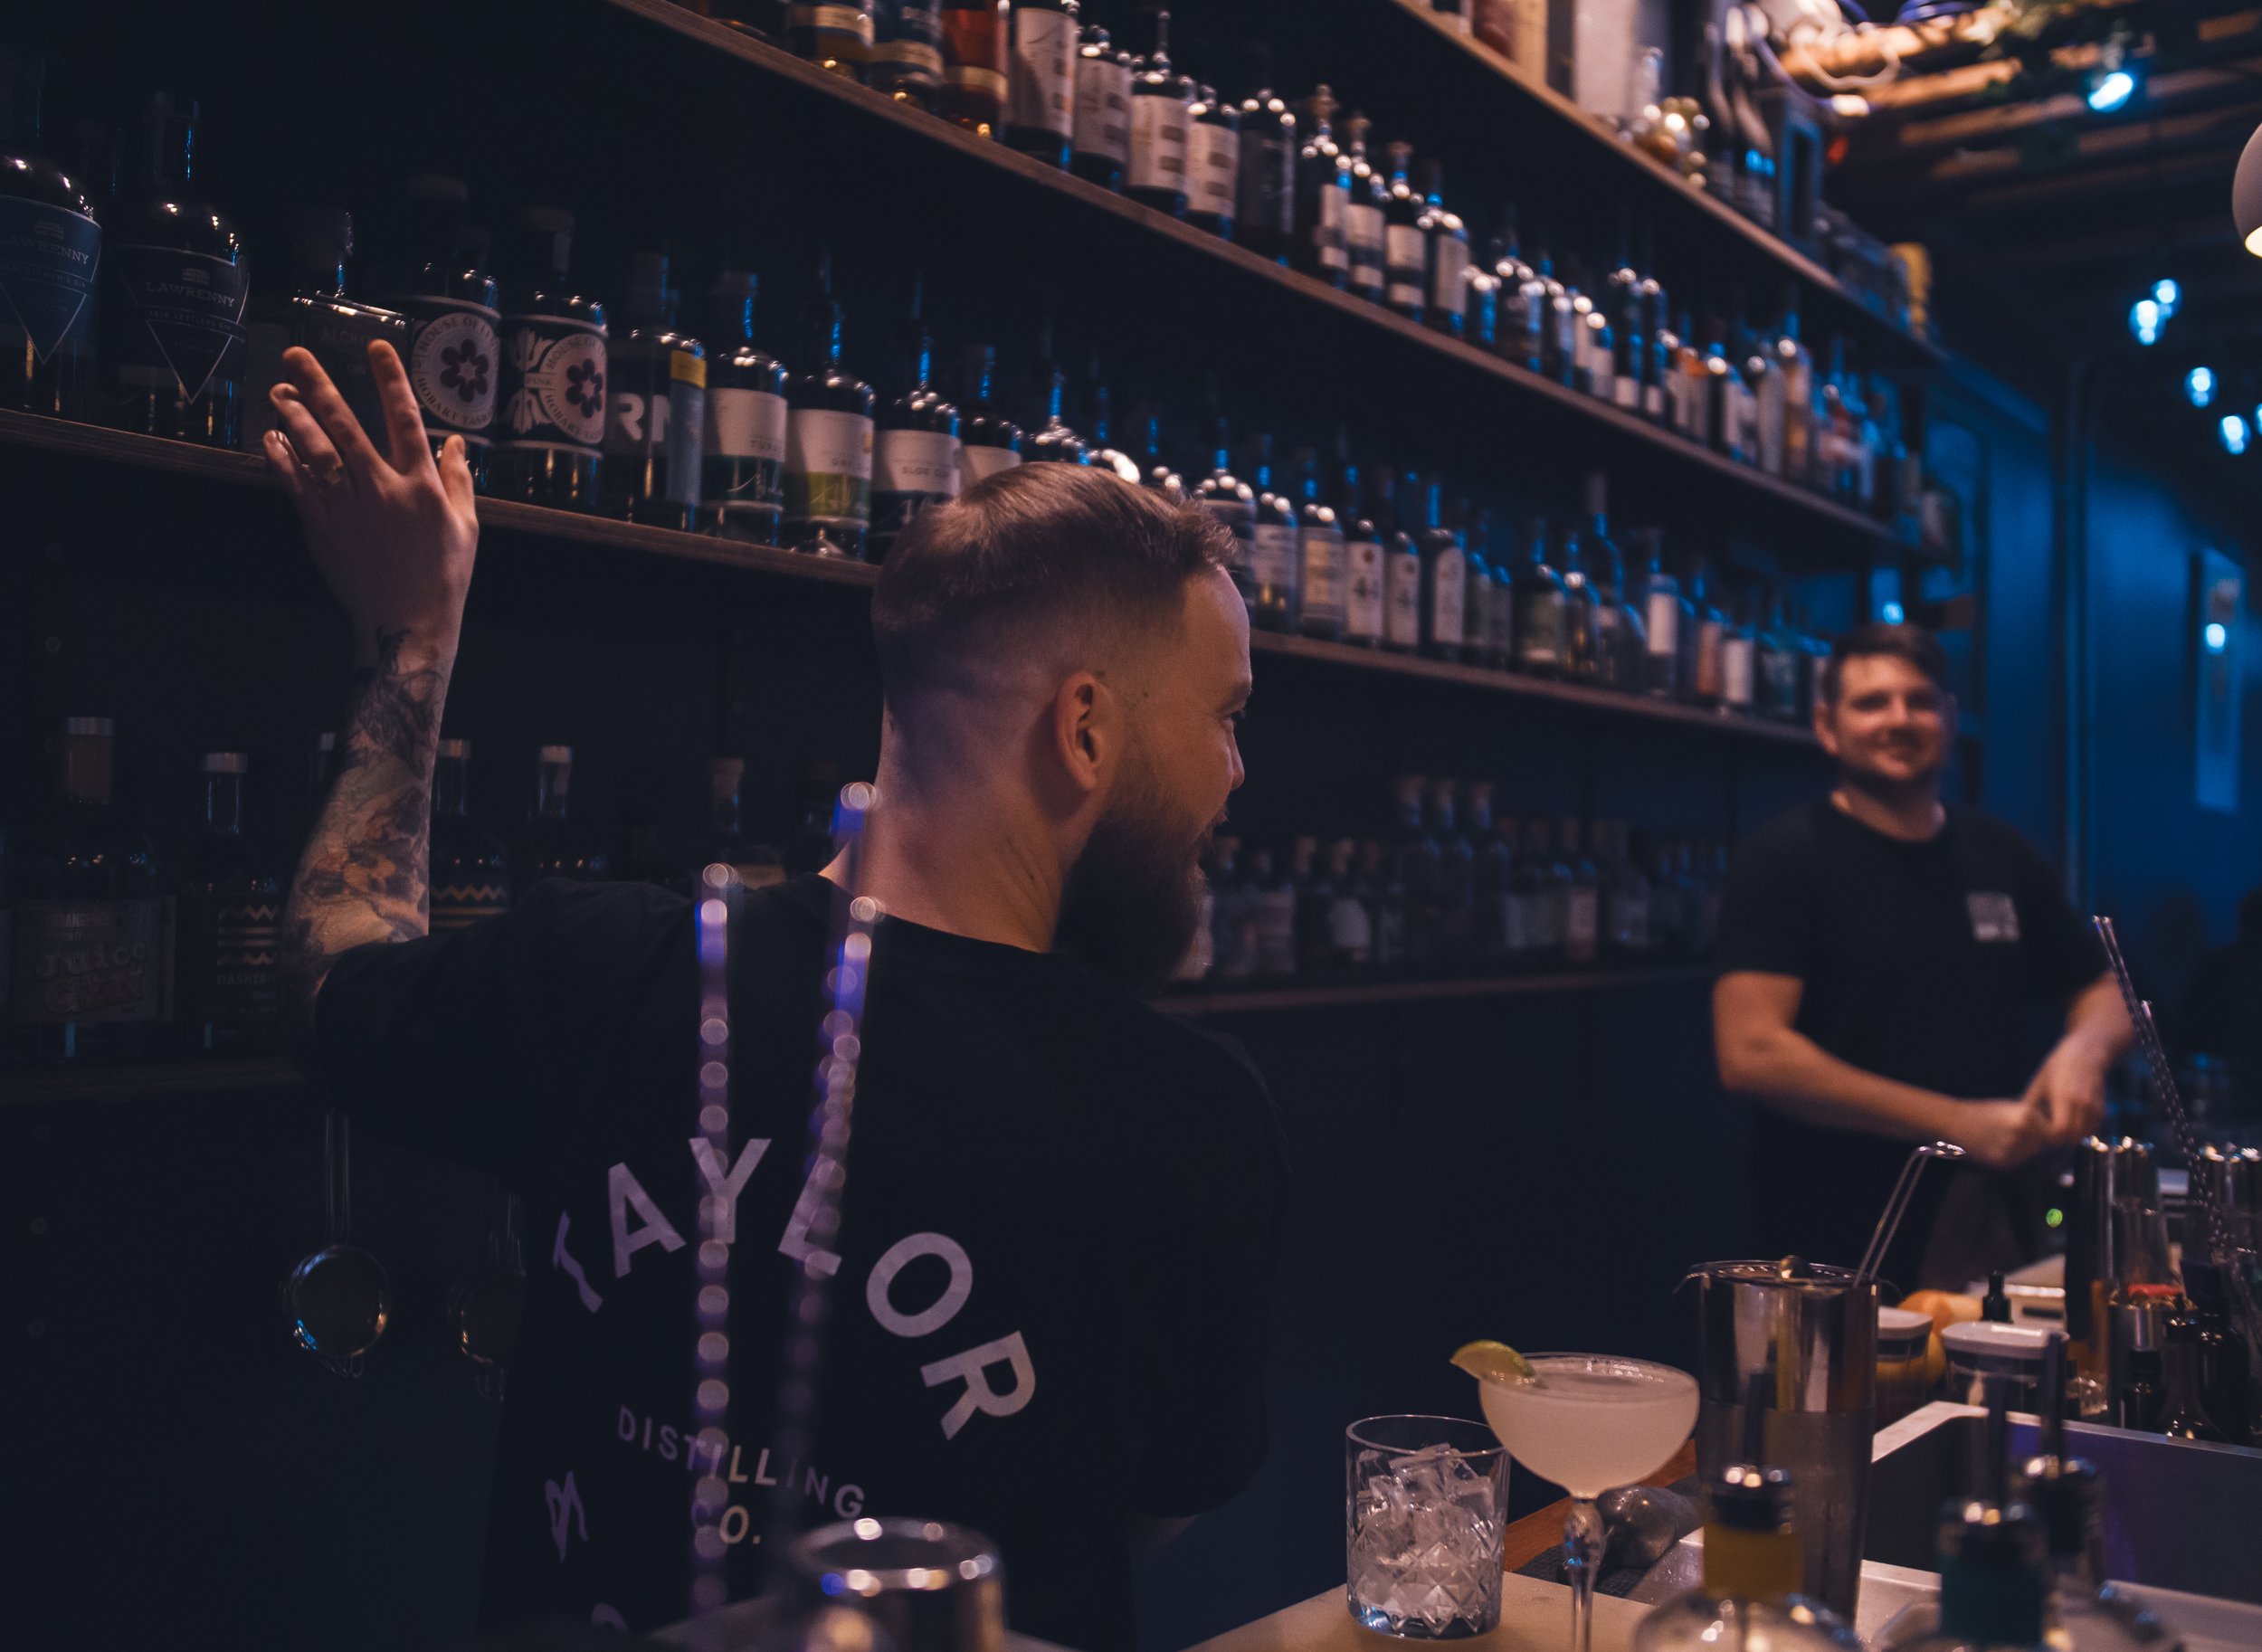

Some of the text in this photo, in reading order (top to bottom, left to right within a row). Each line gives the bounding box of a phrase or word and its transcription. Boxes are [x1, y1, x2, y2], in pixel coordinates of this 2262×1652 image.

[145, 281, 235, 309] LAWRENNY
[553, 1136, 1037, 1442] TAYLOR
[616, 1404, 866, 1519] DISTILLING
